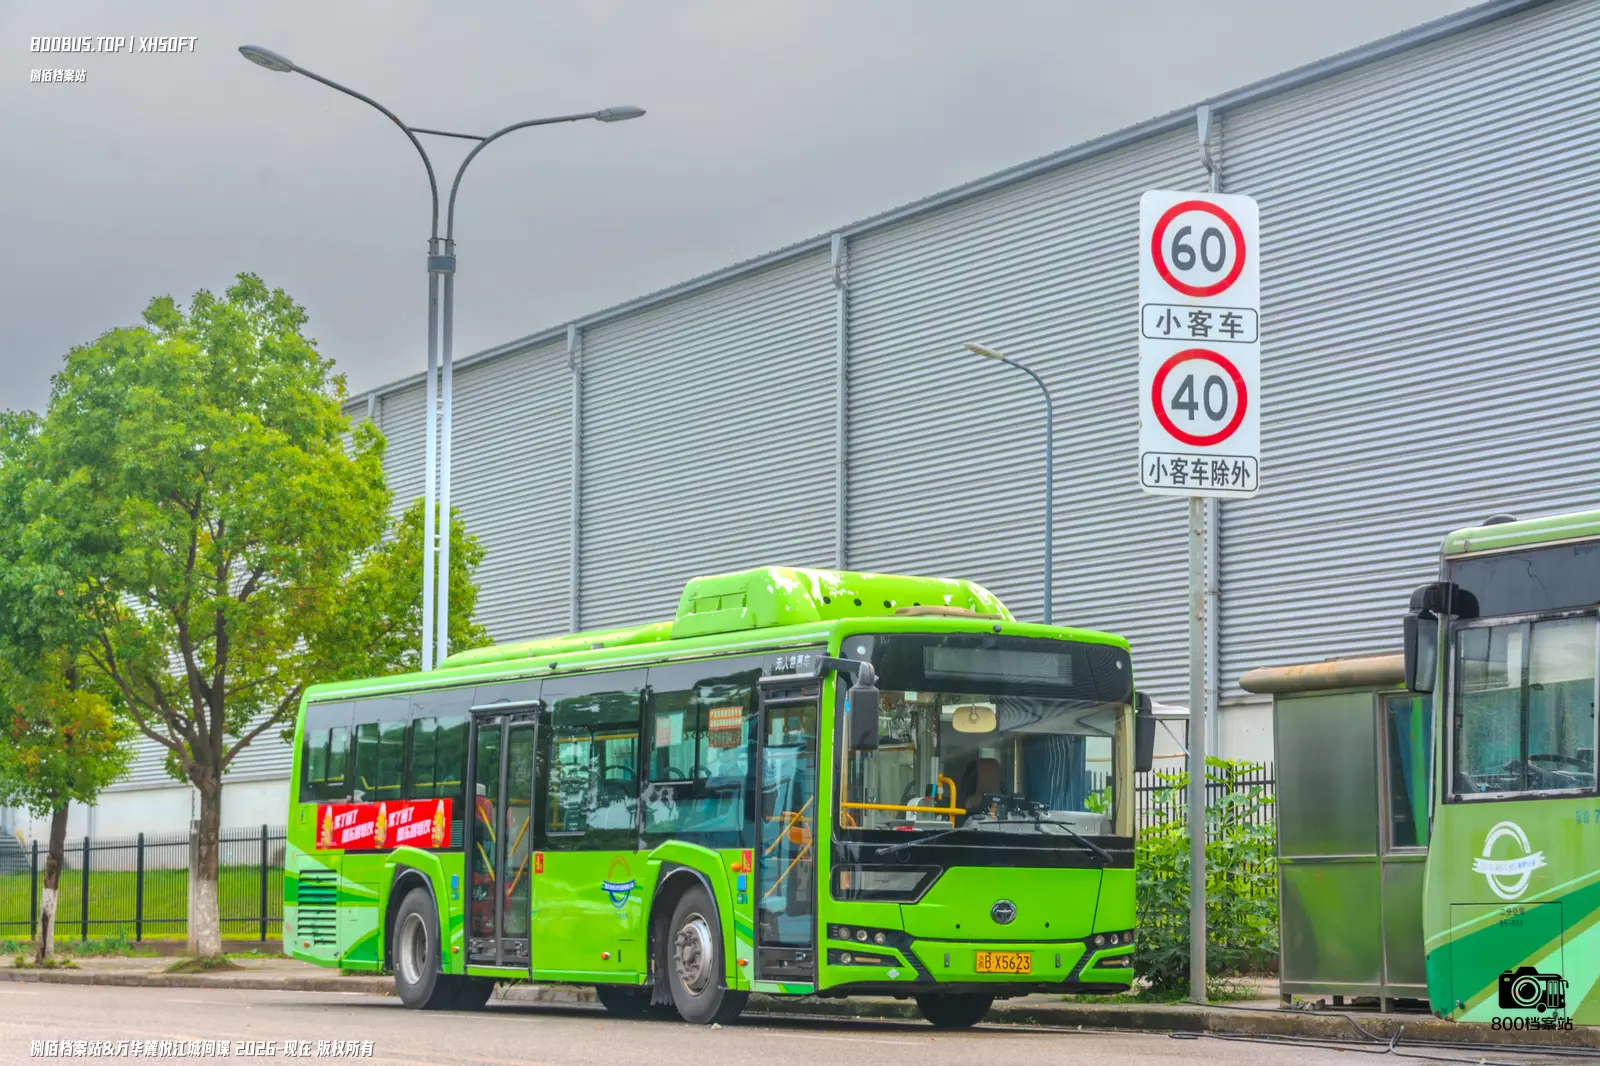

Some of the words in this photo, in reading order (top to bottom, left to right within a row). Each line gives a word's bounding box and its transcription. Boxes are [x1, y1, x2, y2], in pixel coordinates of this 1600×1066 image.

[1171, 226, 1227, 273] 60
[1156, 307, 1245, 339] 小客车
[1171, 374, 1229, 422] 40
[1148, 456, 1251, 488] 小客车除外
[995, 955, 1030, 970] X5623
